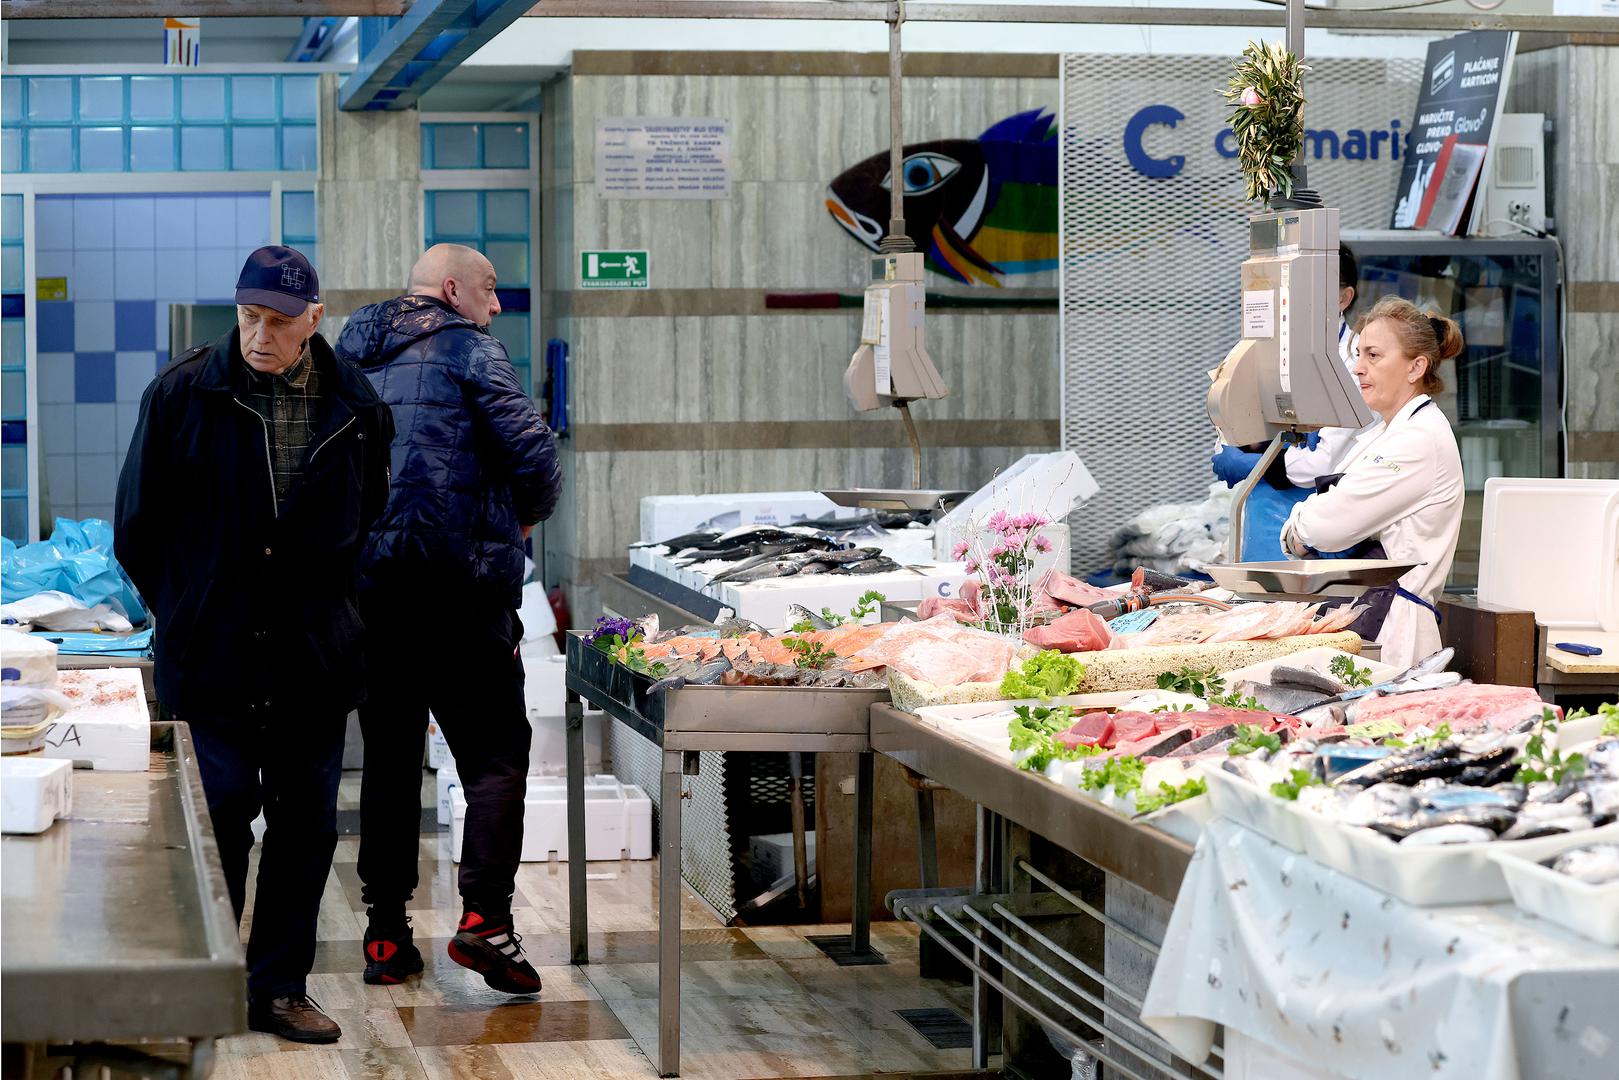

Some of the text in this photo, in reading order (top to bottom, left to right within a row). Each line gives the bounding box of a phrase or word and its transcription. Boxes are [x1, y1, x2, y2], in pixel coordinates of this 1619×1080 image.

[1460, 72, 1499, 88] KARTICOM
[1419, 108, 1455, 125] NARUČITE
[1454, 113, 1483, 134] Glovo
[1426, 125, 1451, 139] PREKO
